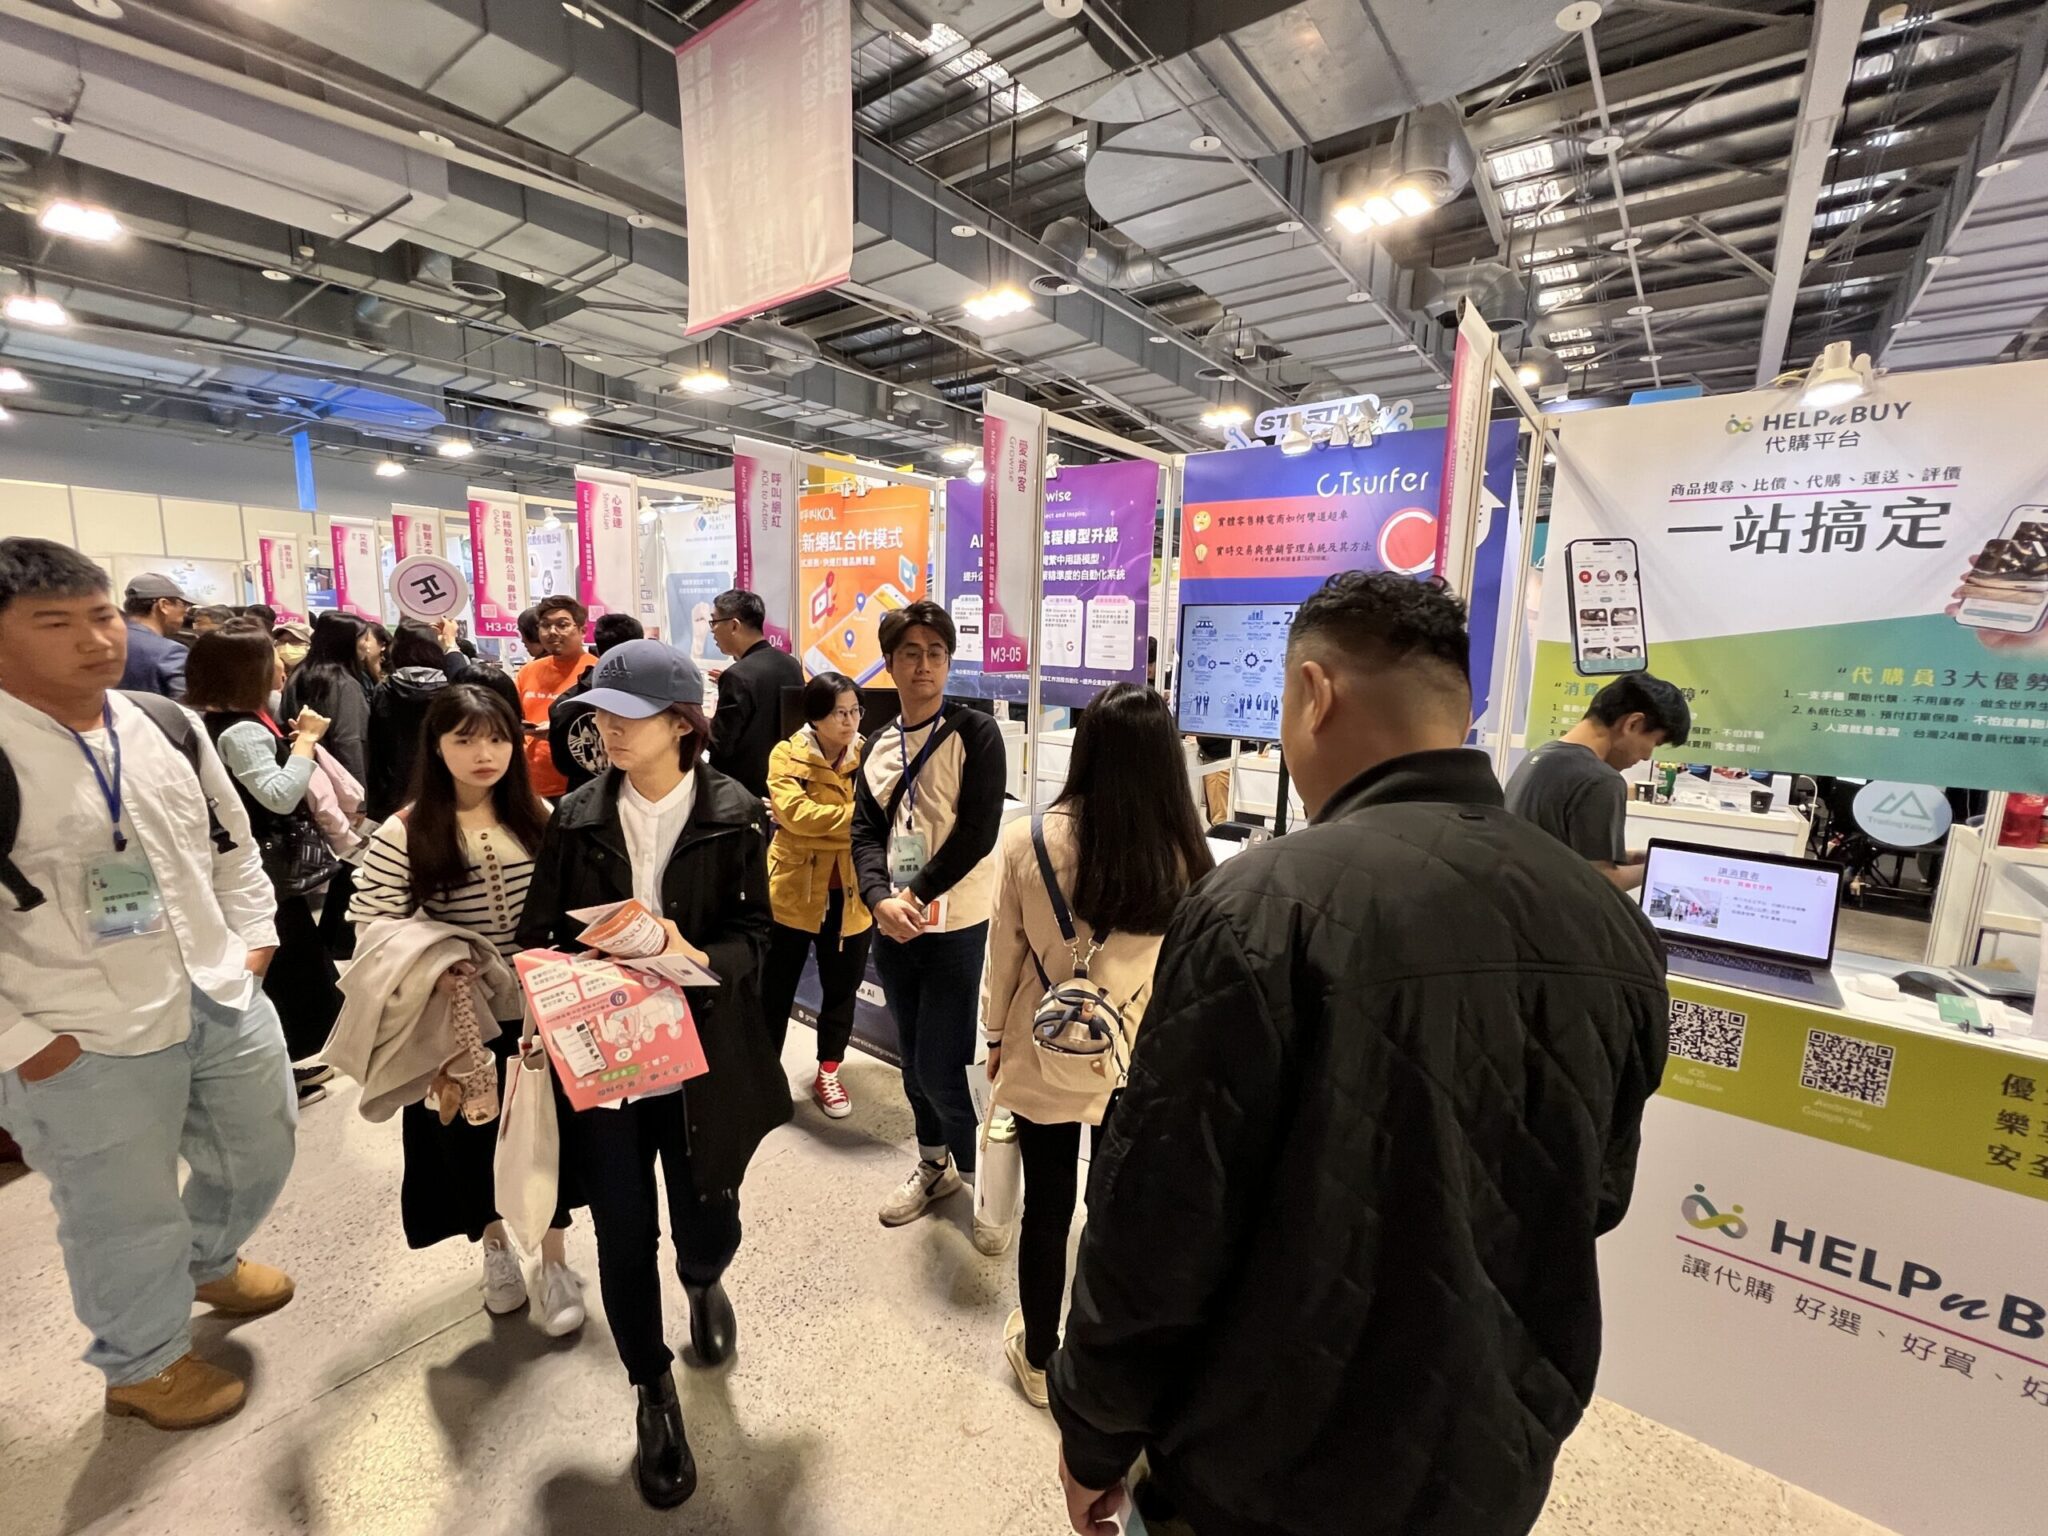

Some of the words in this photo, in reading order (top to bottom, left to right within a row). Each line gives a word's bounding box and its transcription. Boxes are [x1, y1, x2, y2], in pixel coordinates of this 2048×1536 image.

[1762, 401, 1911, 431] HELPnBUY
[1765, 430, 1861, 453] 代購平台
[1008, 436, 1017, 482] Growise
[761, 470, 769, 486] KOL
[1316, 467, 1429, 498] CTsurfer
[1671, 466, 1962, 496] 商品搜尋、比價、代購、運送、評價
[761, 502, 769, 531] Action
[1667, 496, 1951, 554] 一站搞定
[799, 525, 903, 553] 新網紅合作模式
[990, 646, 1021, 663] M3-05
[1682, 1253, 1776, 1305] 讓代購
